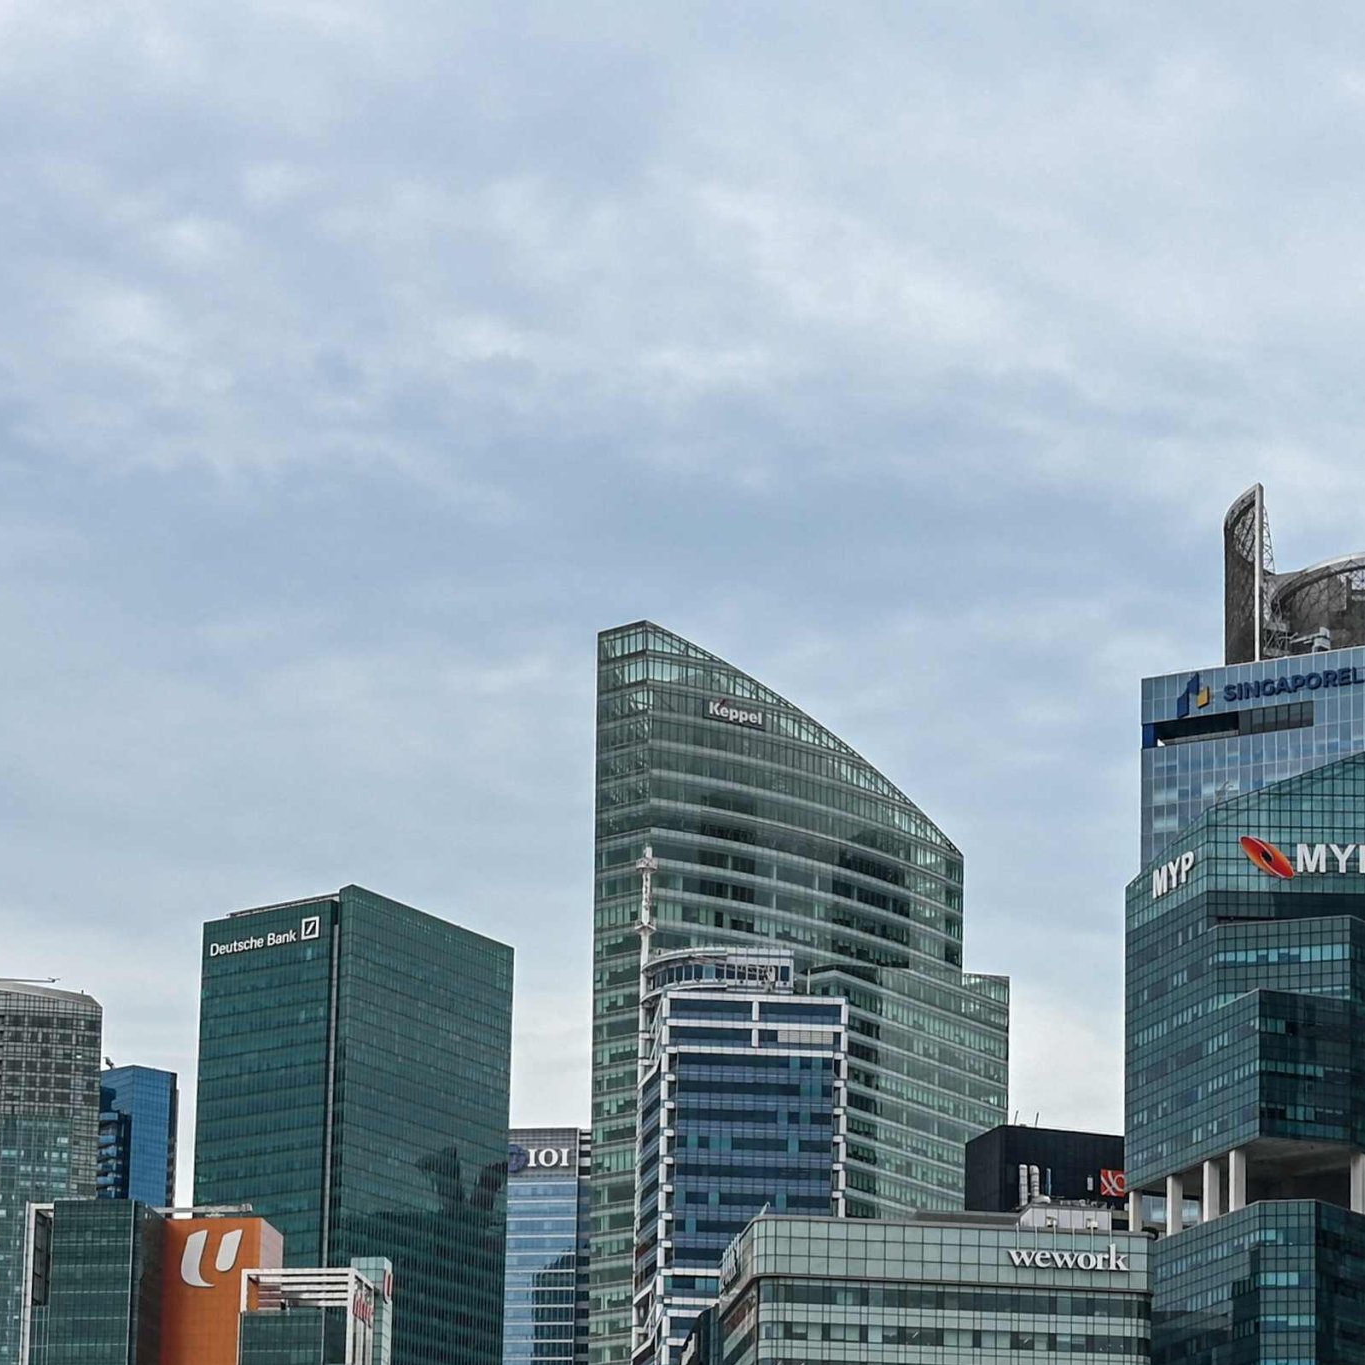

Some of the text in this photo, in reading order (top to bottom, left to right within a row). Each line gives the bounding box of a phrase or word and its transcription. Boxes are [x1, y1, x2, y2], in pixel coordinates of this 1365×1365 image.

[709, 701, 763, 725] Keppel
[1152, 850, 1195, 899] MYP
[209, 929, 297, 957] Deutsche Bank
[527, 1148, 570, 1167] IOI
[1007, 1243, 1130, 1271] wework
